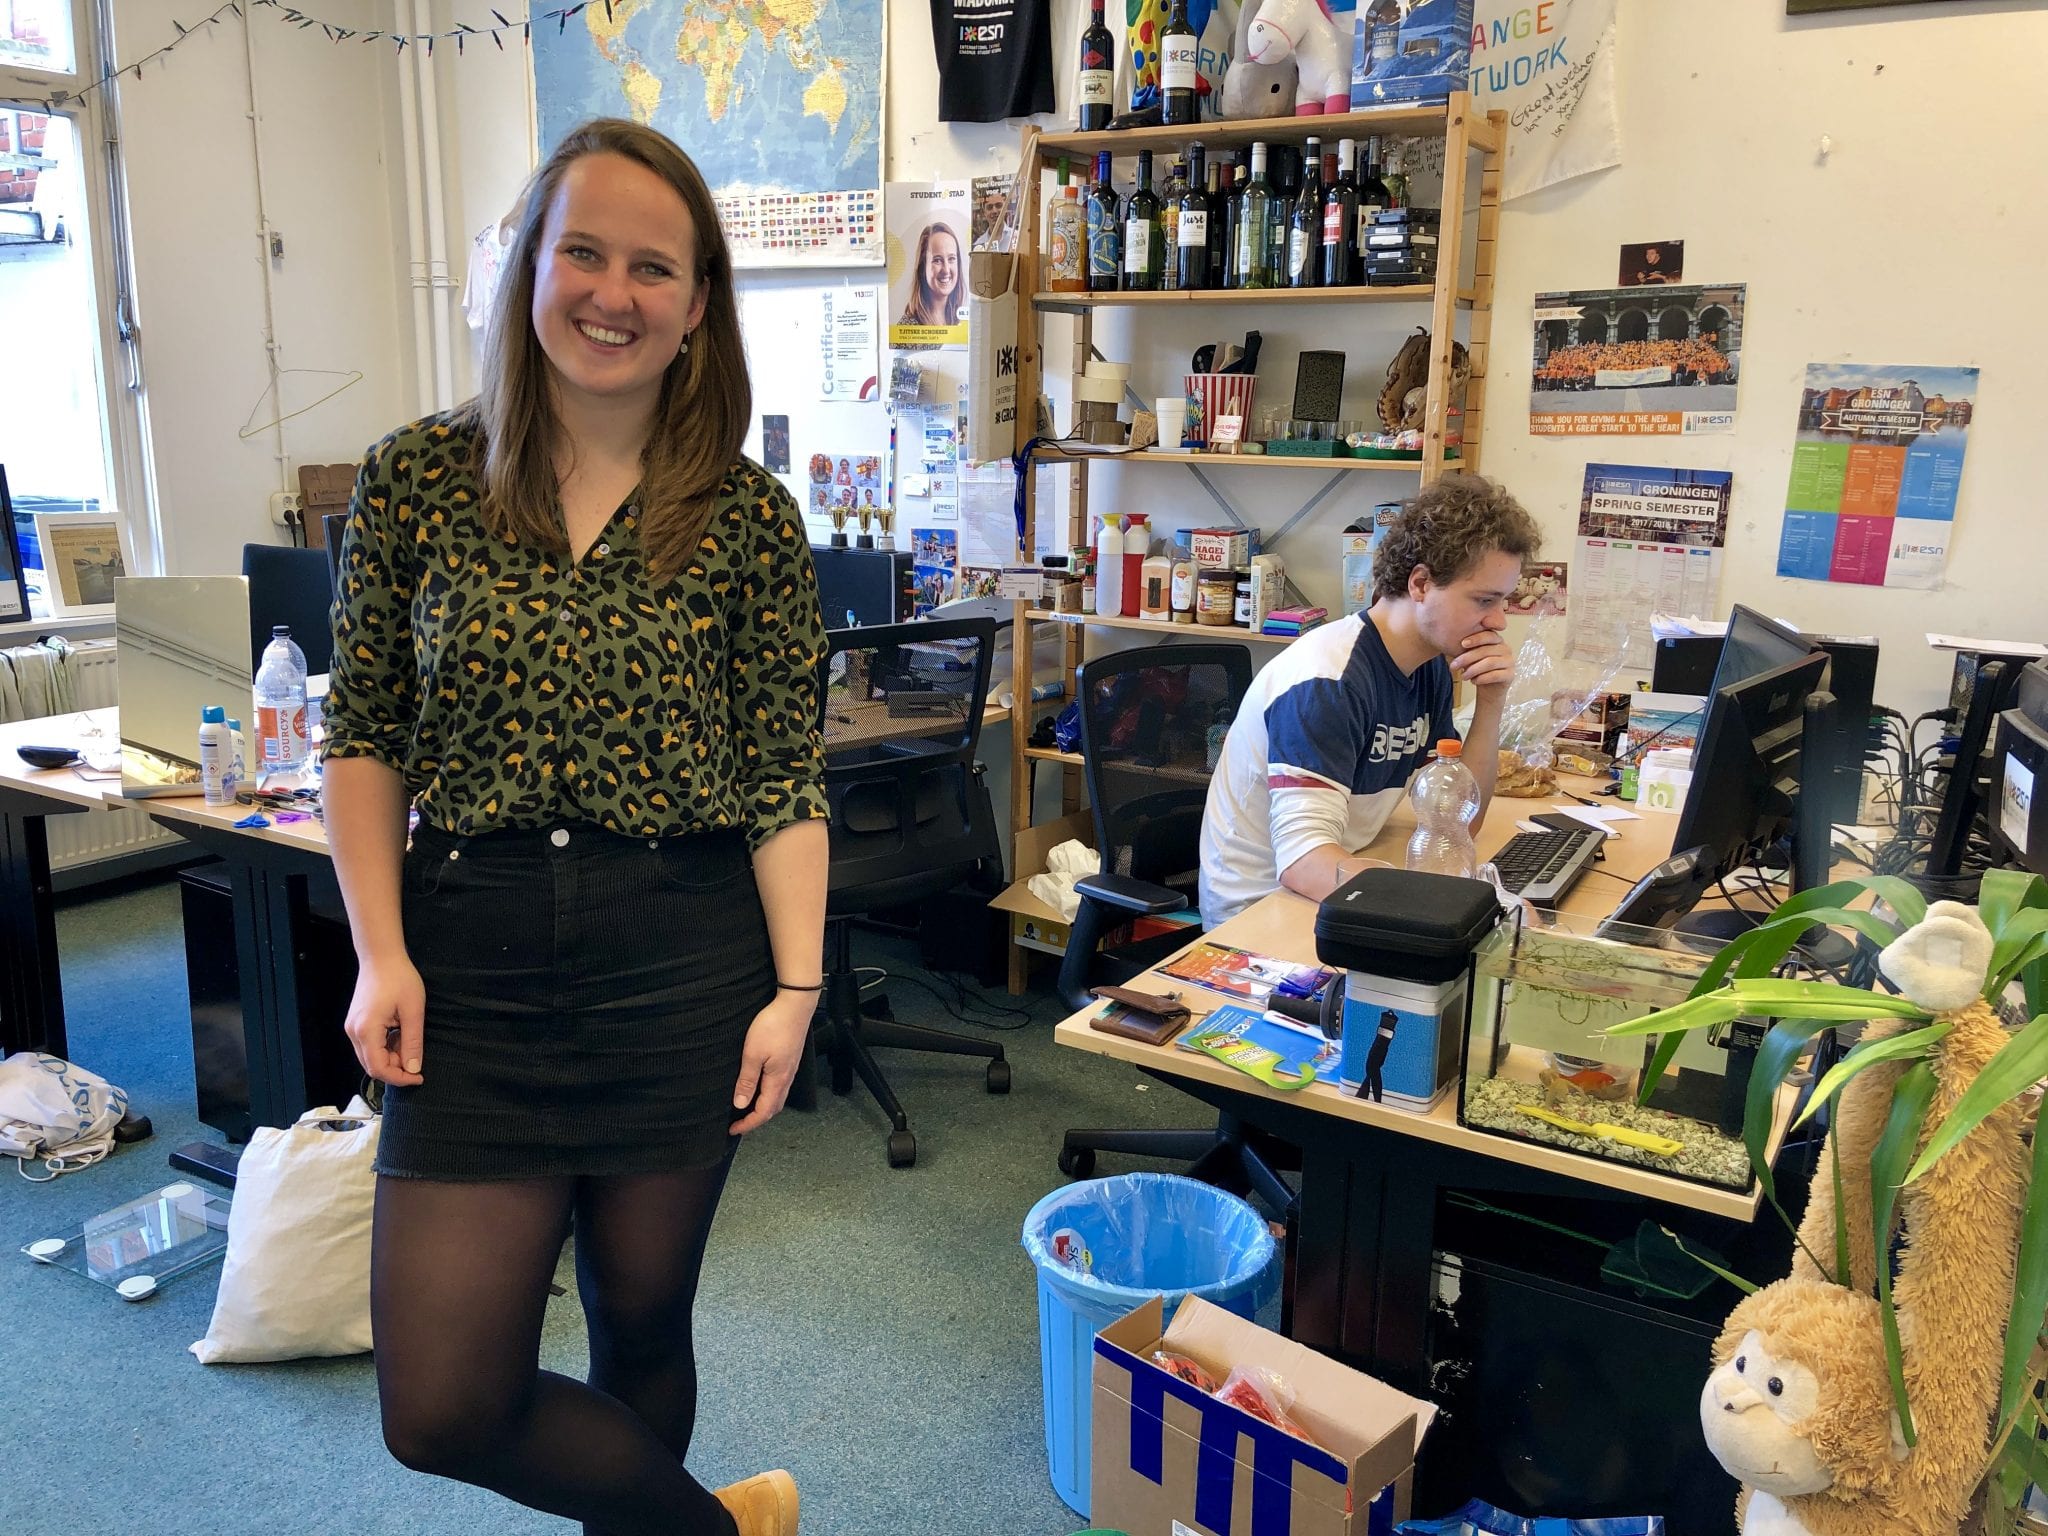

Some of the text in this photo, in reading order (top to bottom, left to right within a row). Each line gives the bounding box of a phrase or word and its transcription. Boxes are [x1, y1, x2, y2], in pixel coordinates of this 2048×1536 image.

[910, 191, 942, 199] STUDENT
[1183, 213, 1204, 226] Just
[821, 291, 834, 395] Certificaat
[1871, 389, 1892, 399] ESN
[1851, 398, 1912, 410] GRONINGEN
[1531, 414, 1668, 424] THANK YOU FOR GIVING ALL THE NEW
[1843, 414, 1917, 424] AUTUMN SEMESTER
[1530, 424, 1565, 433] STUDENTS
[1567, 424, 1573, 433] A
[1576, 424, 1598, 433] GREAT
[1600, 424, 1623, 432] START
[1627, 424, 1637, 432] TO
[1640, 424, 1655, 432] THE
[1642, 484, 1718, 499] GRONINGEN
[1594, 498, 1715, 516] SPRING SEMESTER
[1194, 545, 1226, 555] HAGEL
[1197, 553, 1222, 562] SLAG
[280, 716, 291, 759] SOURCY
